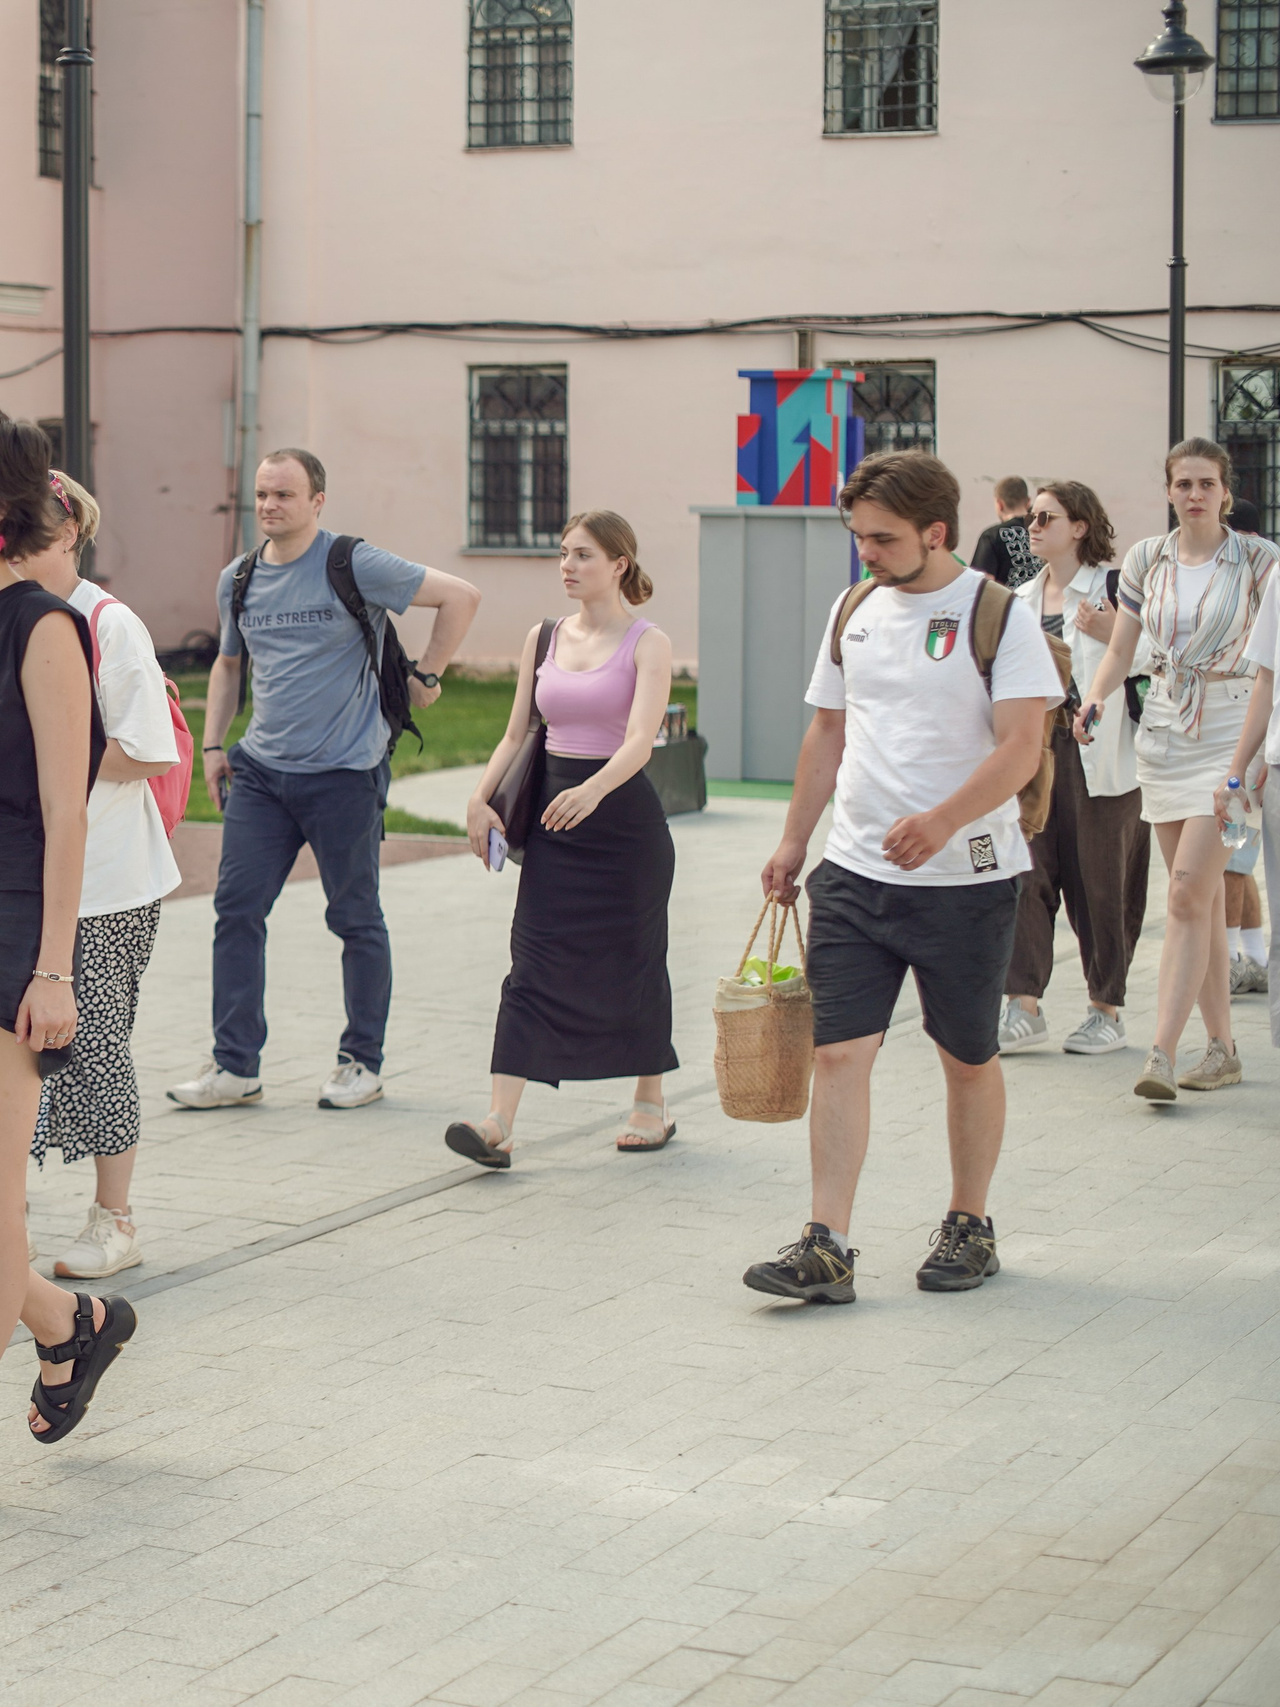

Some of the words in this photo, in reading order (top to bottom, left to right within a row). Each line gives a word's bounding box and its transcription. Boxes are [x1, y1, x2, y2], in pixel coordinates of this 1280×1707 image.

[276, 609, 333, 624] STREETS
[931, 621, 958, 629] ITALIA
[846, 633, 865, 643] PUMA
